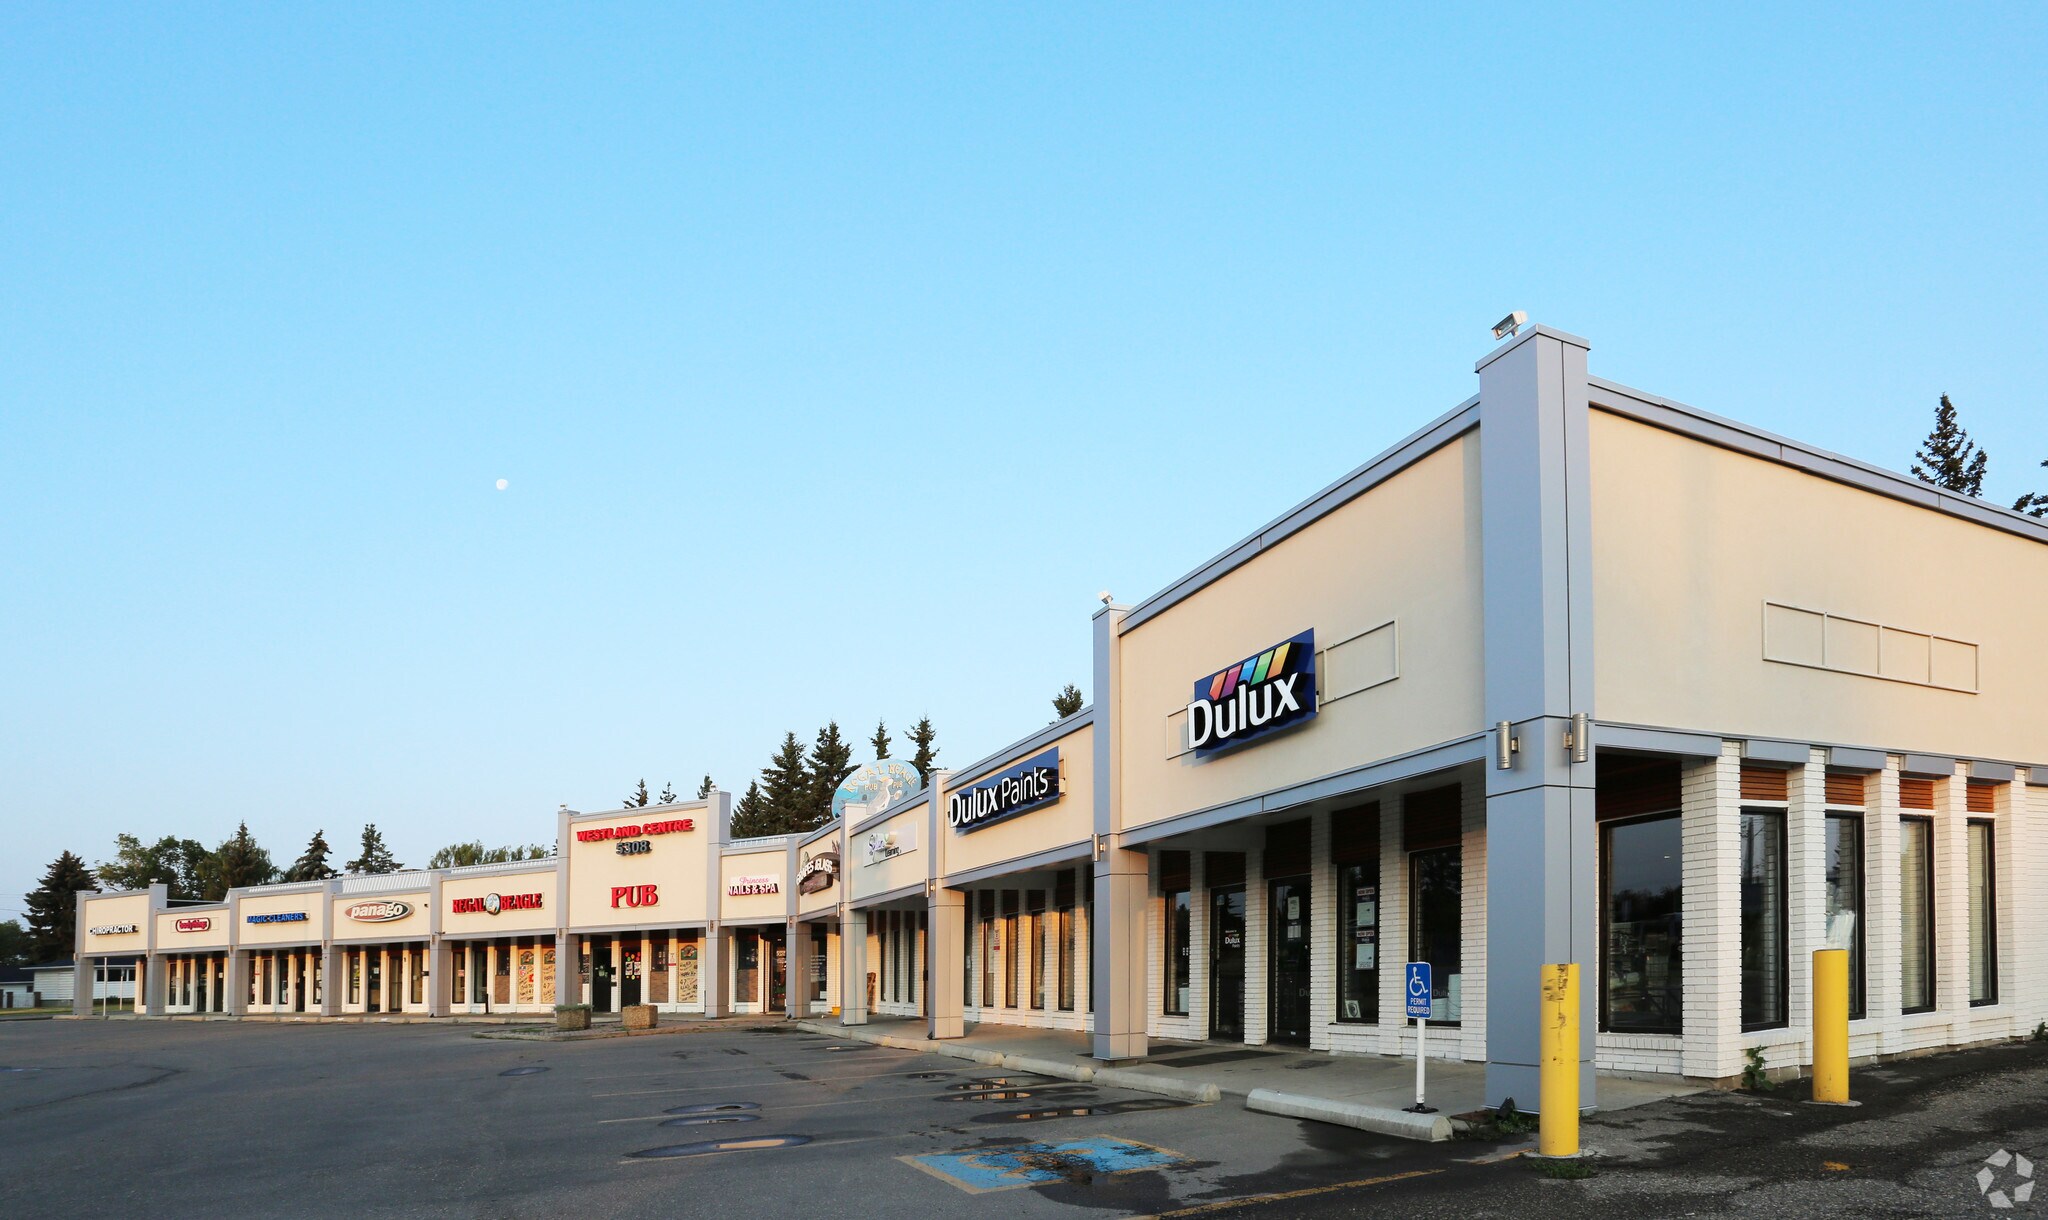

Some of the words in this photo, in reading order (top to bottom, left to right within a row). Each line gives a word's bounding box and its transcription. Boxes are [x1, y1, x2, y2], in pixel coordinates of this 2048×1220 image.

[1187, 672, 1300, 750] Dulux
[864, 783, 877, 791] PUB
[949, 785, 998, 828] Dulux
[1002, 766, 1048, 808] Paints
[577, 825, 641, 842] WESTLAND
[642, 819, 694, 835] CENTRE
[616, 840, 650, 856] 5308
[740, 876, 769, 884] Princess
[727, 884, 752, 895] NAILS
[752, 885, 760, 894] &
[760, 883, 776, 894] SPA
[611, 884, 659, 908] PUB
[452, 897, 485, 913] REGAL
[500, 893, 543, 910] BEAGLE
[350, 902, 404, 919] panago
[247, 914, 267, 923] MAGIC
[269, 912, 304, 922] CLEANERS
[89, 925, 133, 935] CHIROPRACTOR
[1225, 936, 1240, 944] Dulux
[1410, 997, 1426, 1006] PERMIT
[1407, 1005, 1430, 1014] REQUIRED
